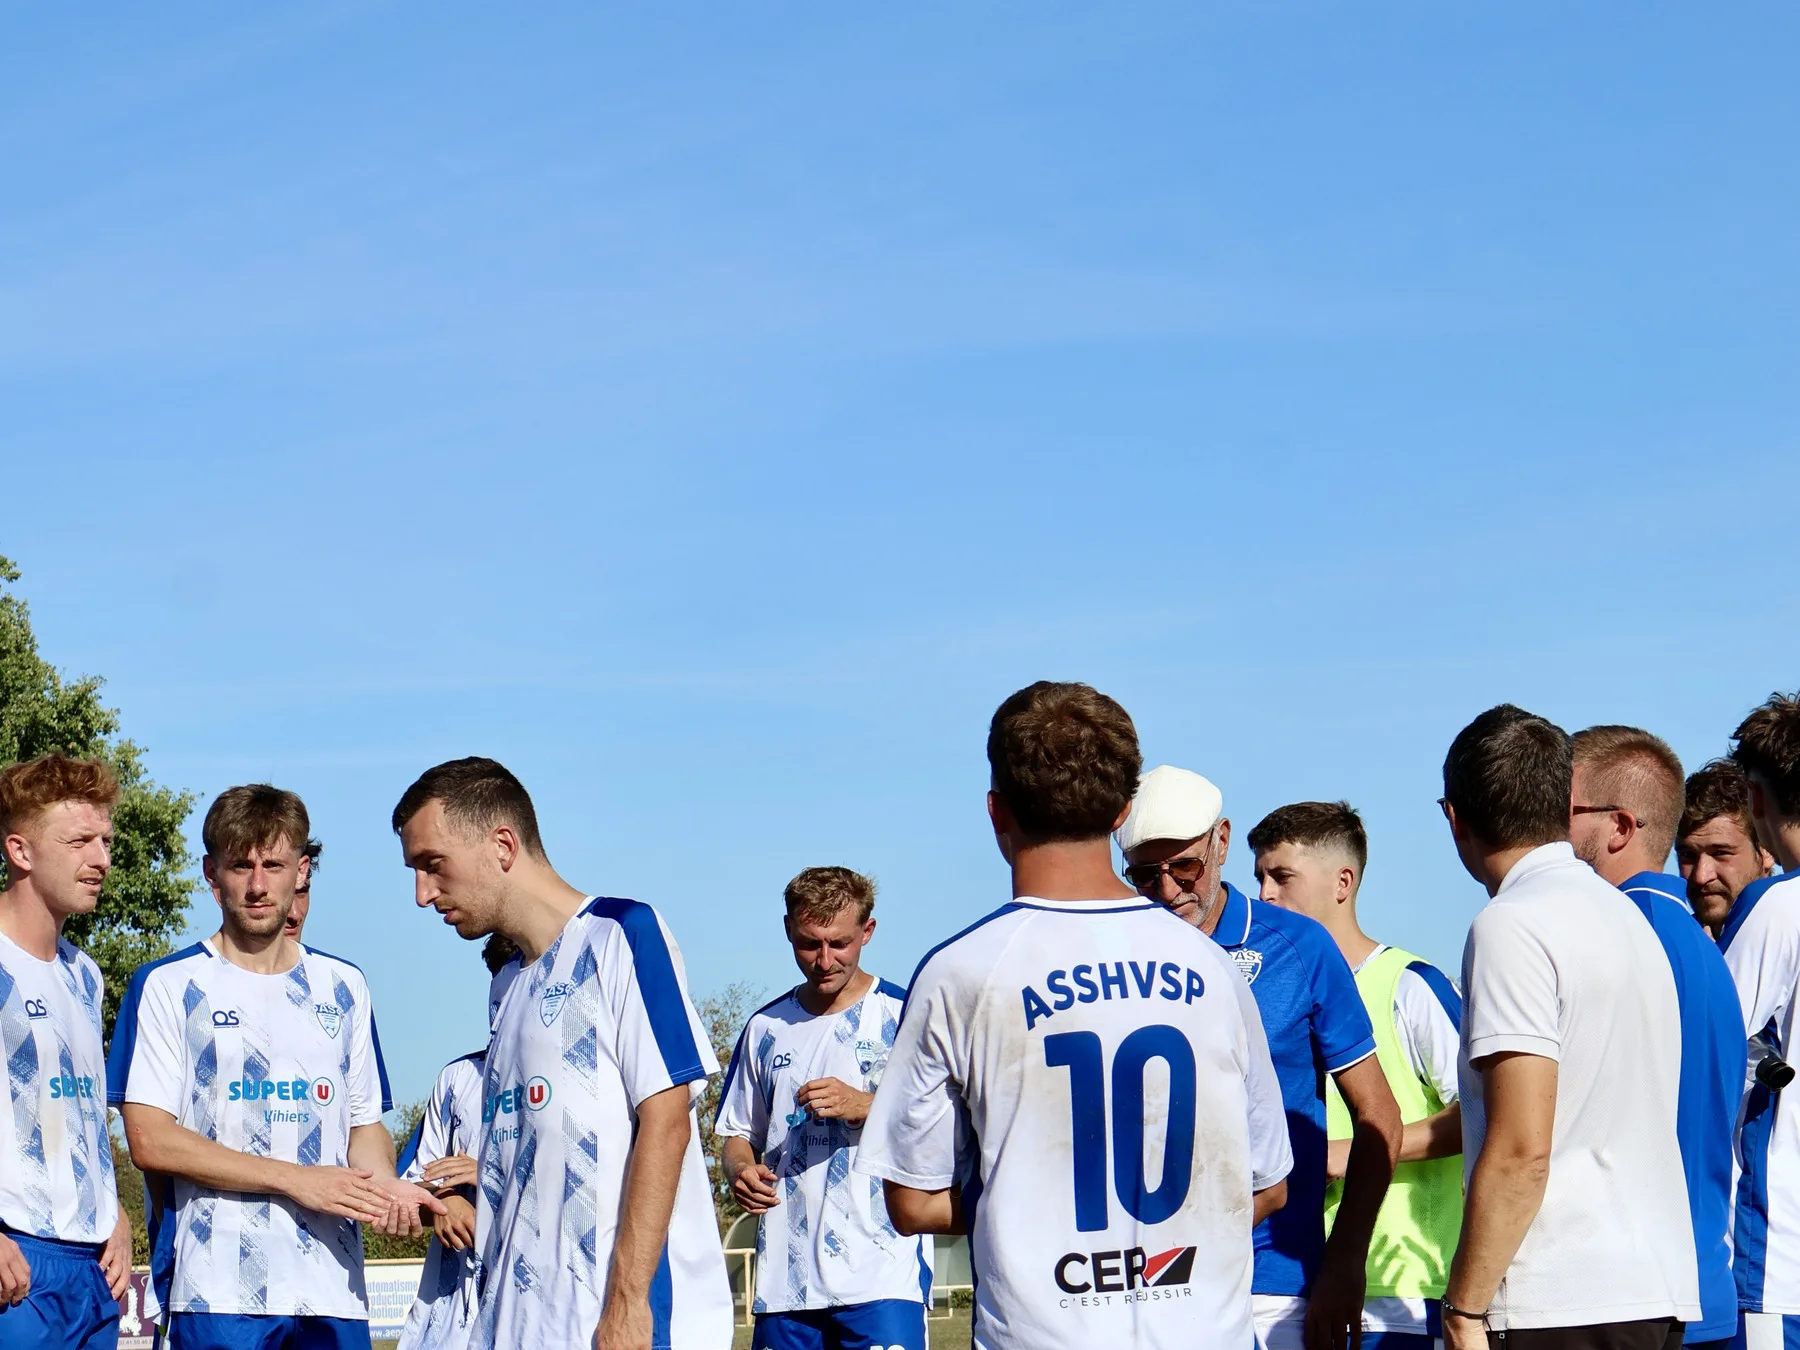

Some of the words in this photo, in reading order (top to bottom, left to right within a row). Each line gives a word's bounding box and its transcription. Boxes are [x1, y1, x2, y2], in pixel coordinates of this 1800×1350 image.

[1234, 951, 1256, 961] AS
[1021, 961, 1206, 1031] ASSHVSP
[229, 1080, 309, 1101] SUPER
[317, 1084, 329, 1100] U
[530, 1084, 544, 1104] U
[264, 1109, 310, 1123] Vihiers
[1044, 1024, 1197, 1233] 10
[801, 1133, 838, 1147] Vihiers
[1054, 1246, 1150, 1294] CER
[367, 1280, 418, 1293] utomatisme
[1059, 1296, 1112, 1309] C'EST
